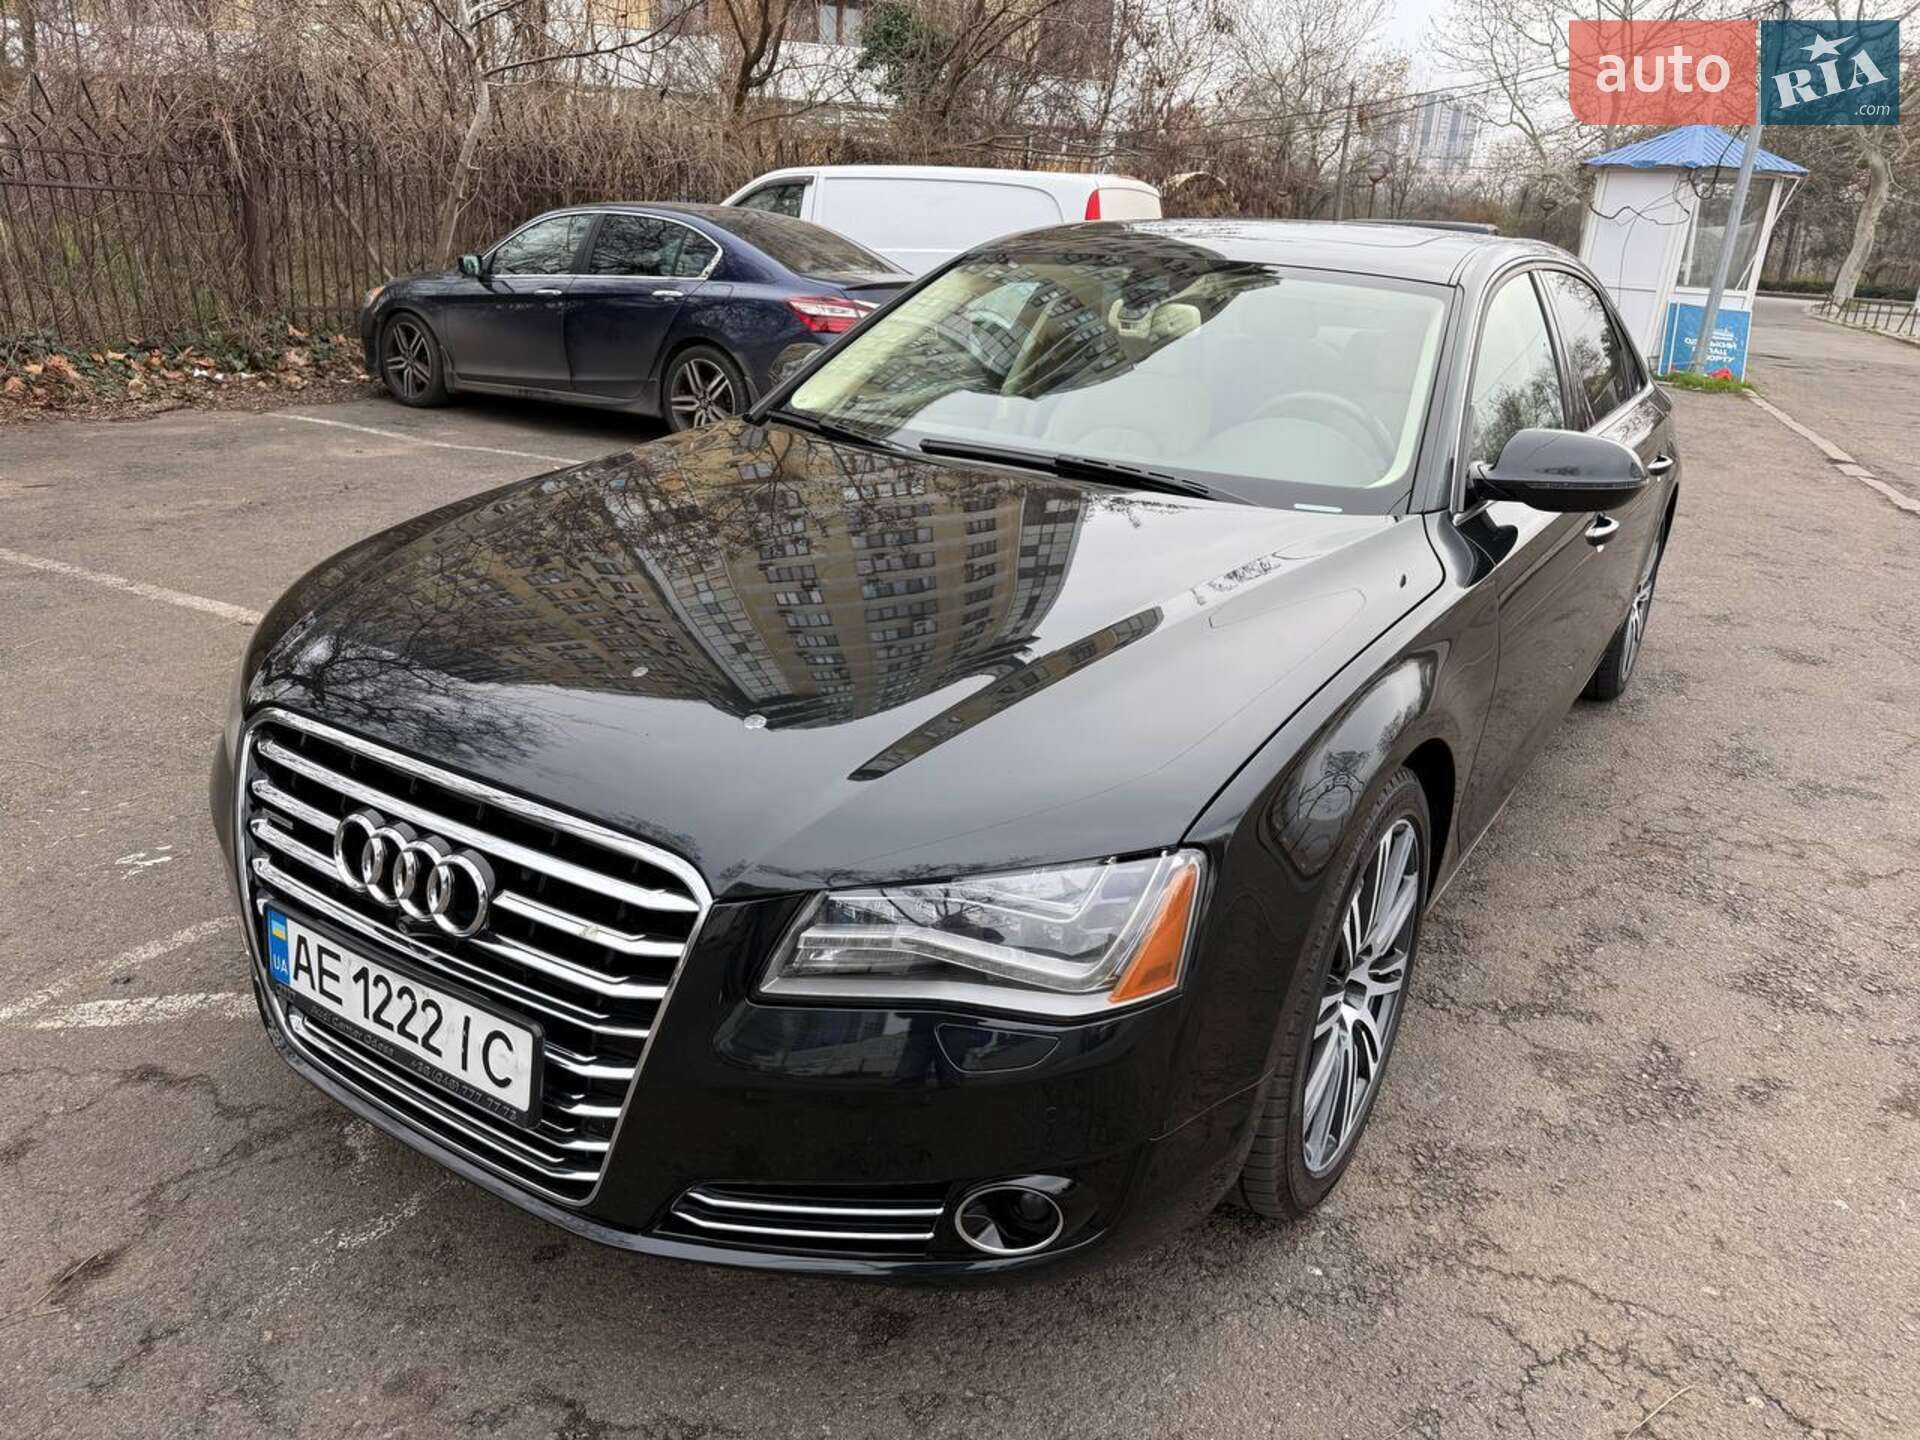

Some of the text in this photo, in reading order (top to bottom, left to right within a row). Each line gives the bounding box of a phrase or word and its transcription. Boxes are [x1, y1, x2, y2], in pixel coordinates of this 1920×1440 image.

[273, 952, 289, 976] UA
[292, 934, 514, 1089] AE 1222 IC
